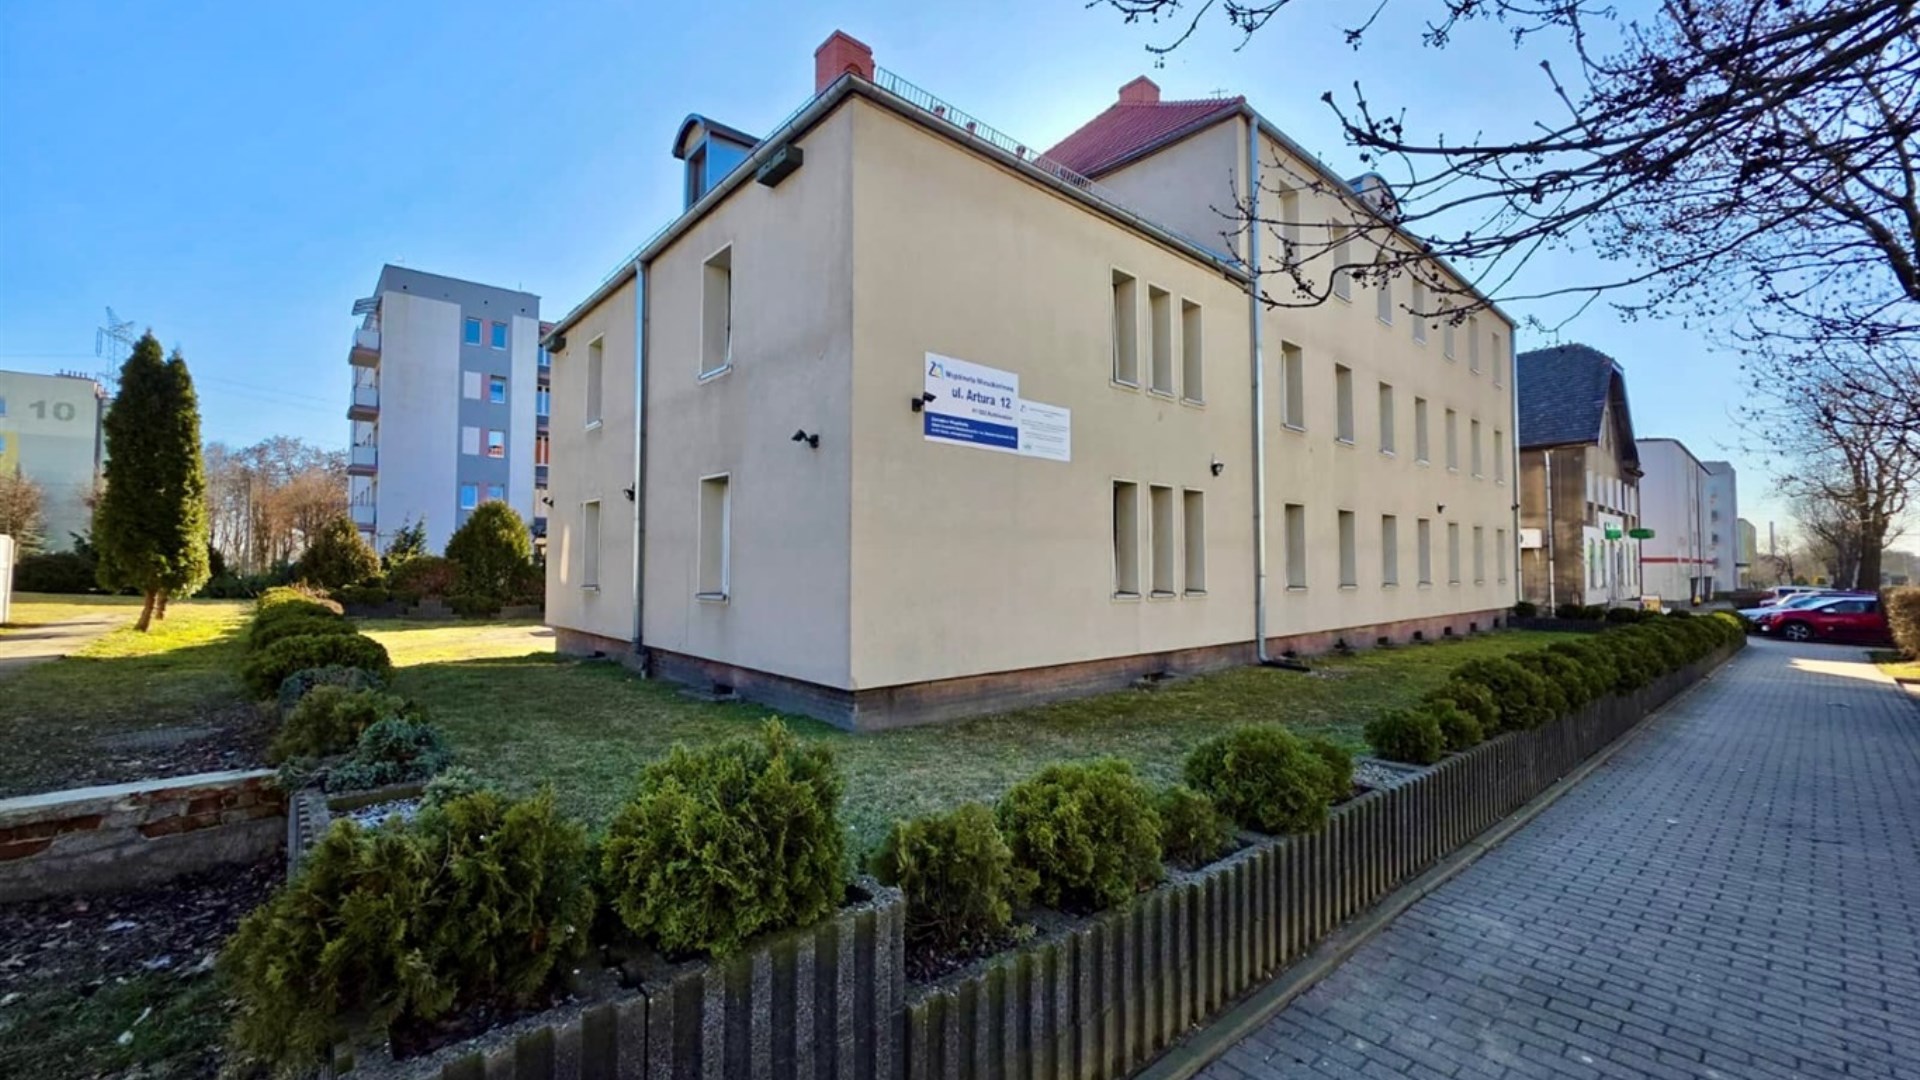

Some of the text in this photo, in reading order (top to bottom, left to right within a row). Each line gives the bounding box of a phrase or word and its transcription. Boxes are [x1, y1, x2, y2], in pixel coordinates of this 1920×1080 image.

[951, 387, 1011, 409] ul. Artura 12
[29, 400, 75, 421] 10
